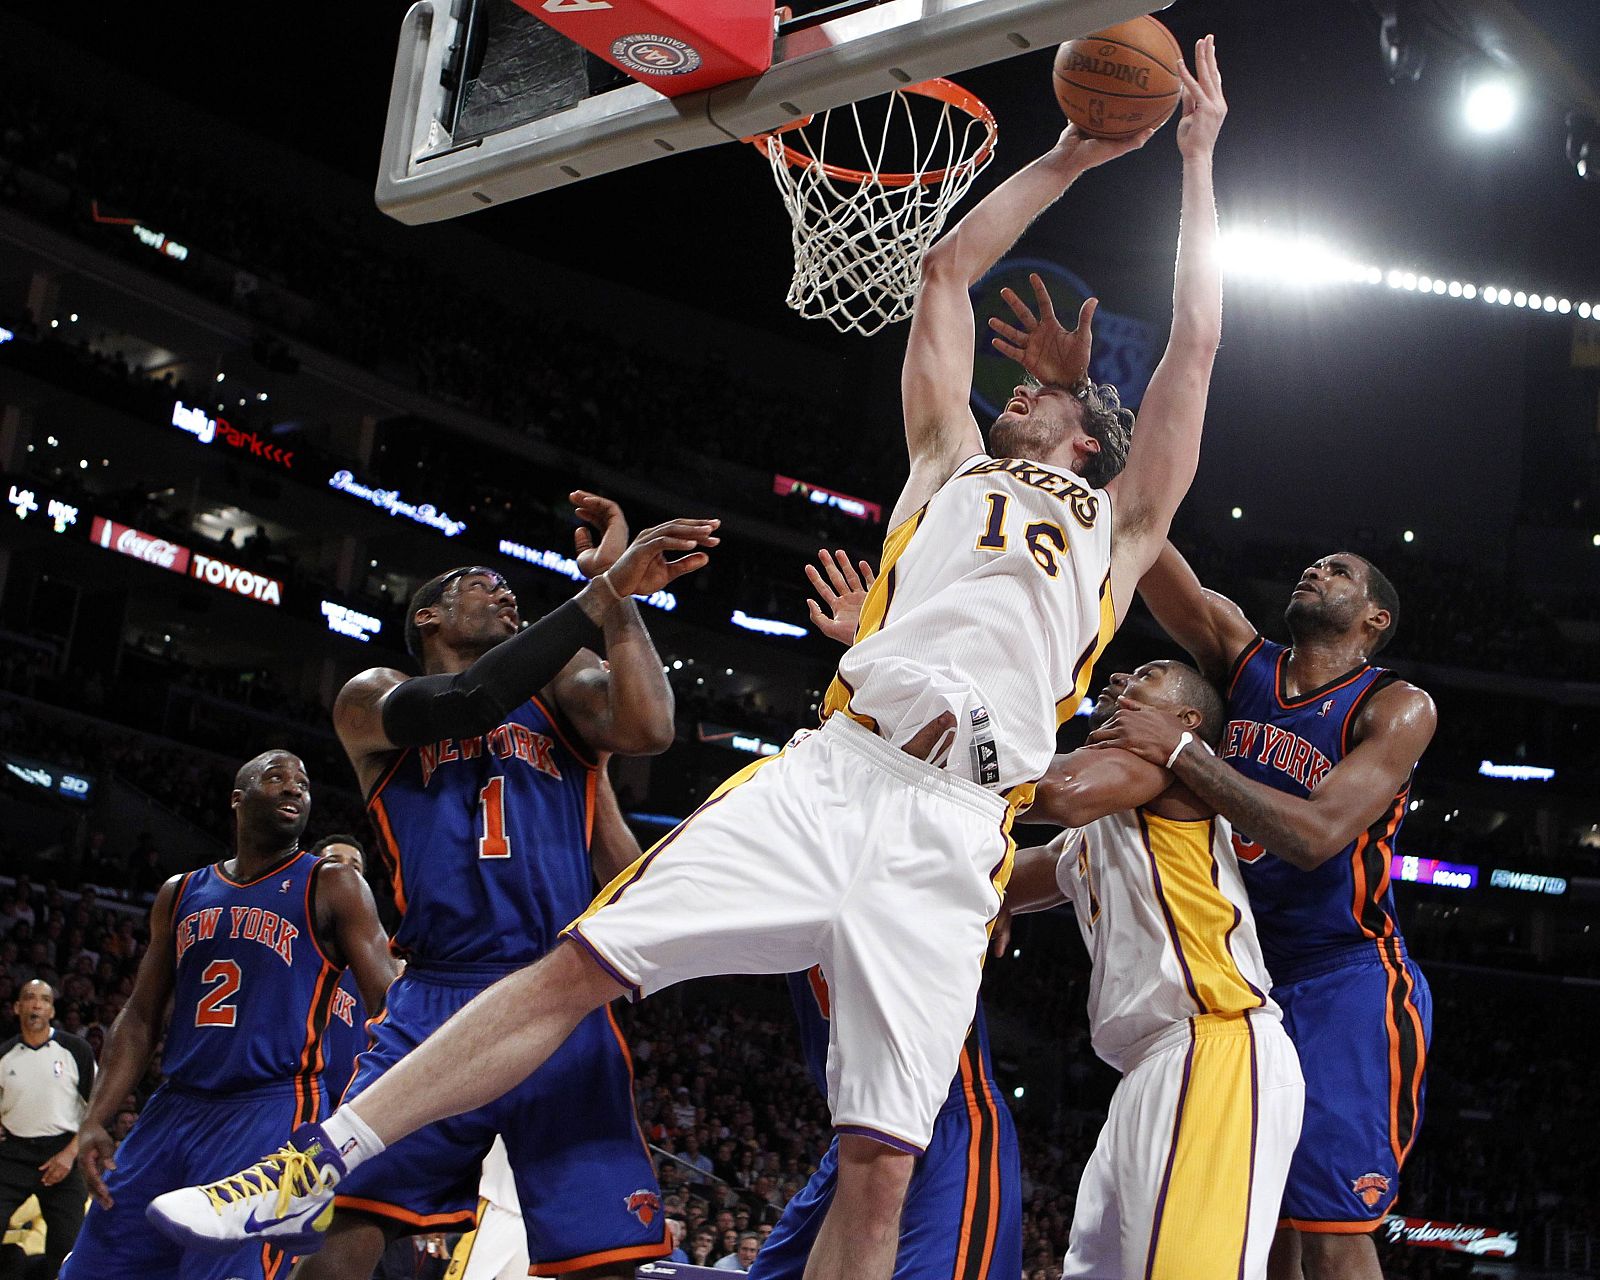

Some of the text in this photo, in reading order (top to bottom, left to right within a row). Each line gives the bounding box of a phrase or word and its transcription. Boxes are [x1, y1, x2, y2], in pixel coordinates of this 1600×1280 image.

[636, 46, 674, 66] AAA
[1064, 53, 1150, 91] SPALDING
[975, 491, 1069, 580] 16
[193, 554, 281, 606] TOYOTA
[1257, 723, 1332, 792] YORK
[479, 775, 512, 859] 1
[229, 906, 299, 967] YORK
[195, 958, 242, 1027] 2
[332, 987, 357, 1028] RK
[1384, 1214, 1486, 1245] Budweiser
